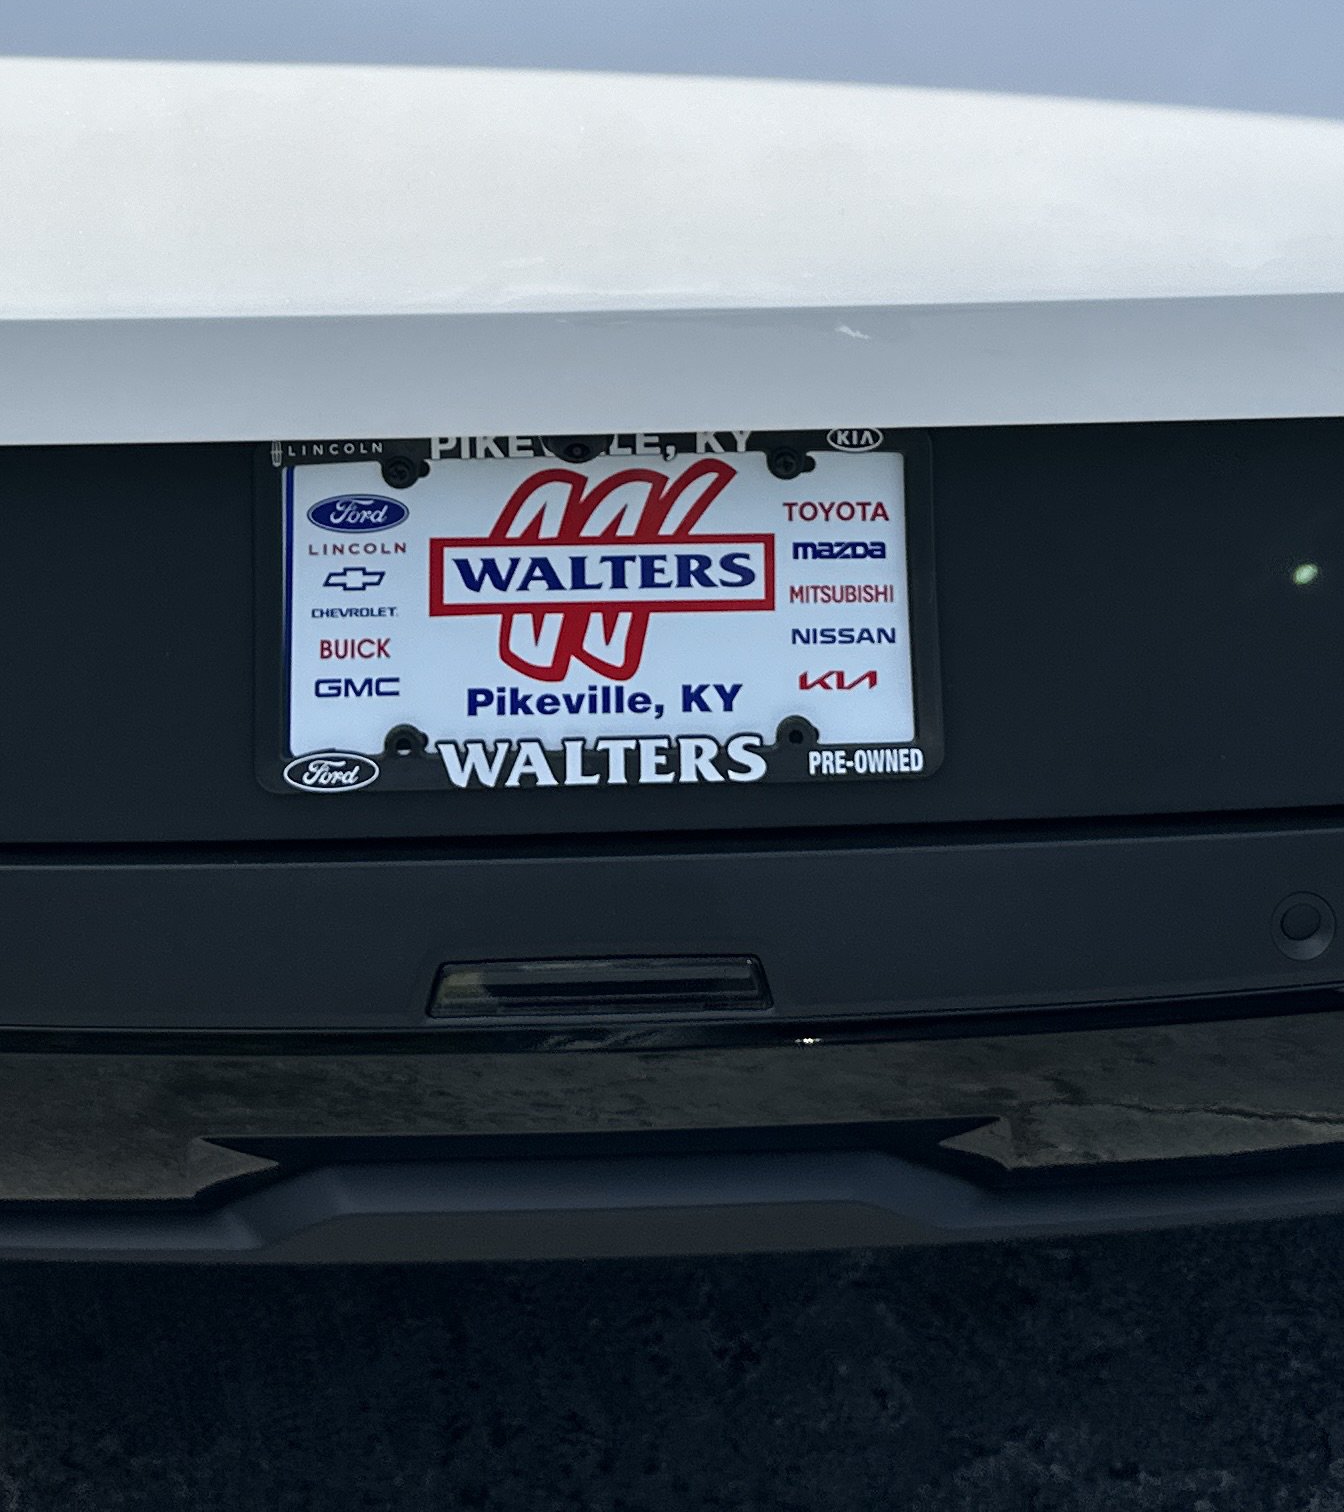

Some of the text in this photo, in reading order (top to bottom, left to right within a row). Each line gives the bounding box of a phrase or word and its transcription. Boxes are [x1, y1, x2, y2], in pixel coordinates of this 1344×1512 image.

[287, 441, 384, 457] LINCOLN
[430, 430, 752, 461] PIKELE, KY
[329, 498, 389, 525] Ford
[783, 501, 890, 523] TOYOTA
[308, 542, 407, 556] LINCOLN
[452, 552, 756, 594] WALTERS
[789, 584, 894, 604] MITSUBISHI
[311, 606, 397, 619] CHEVROLET
[791, 627, 896, 645] NISSAN
[319, 638, 391, 660] BUICK
[314, 676, 401, 698] GMC
[798, 670, 878, 691] KIA
[466, 683, 744, 719] Pikeville, KY
[435, 733, 768, 788] WALTERS
[808, 747, 924, 776] PRE-OWNED
[301, 760, 359, 786] Ford
